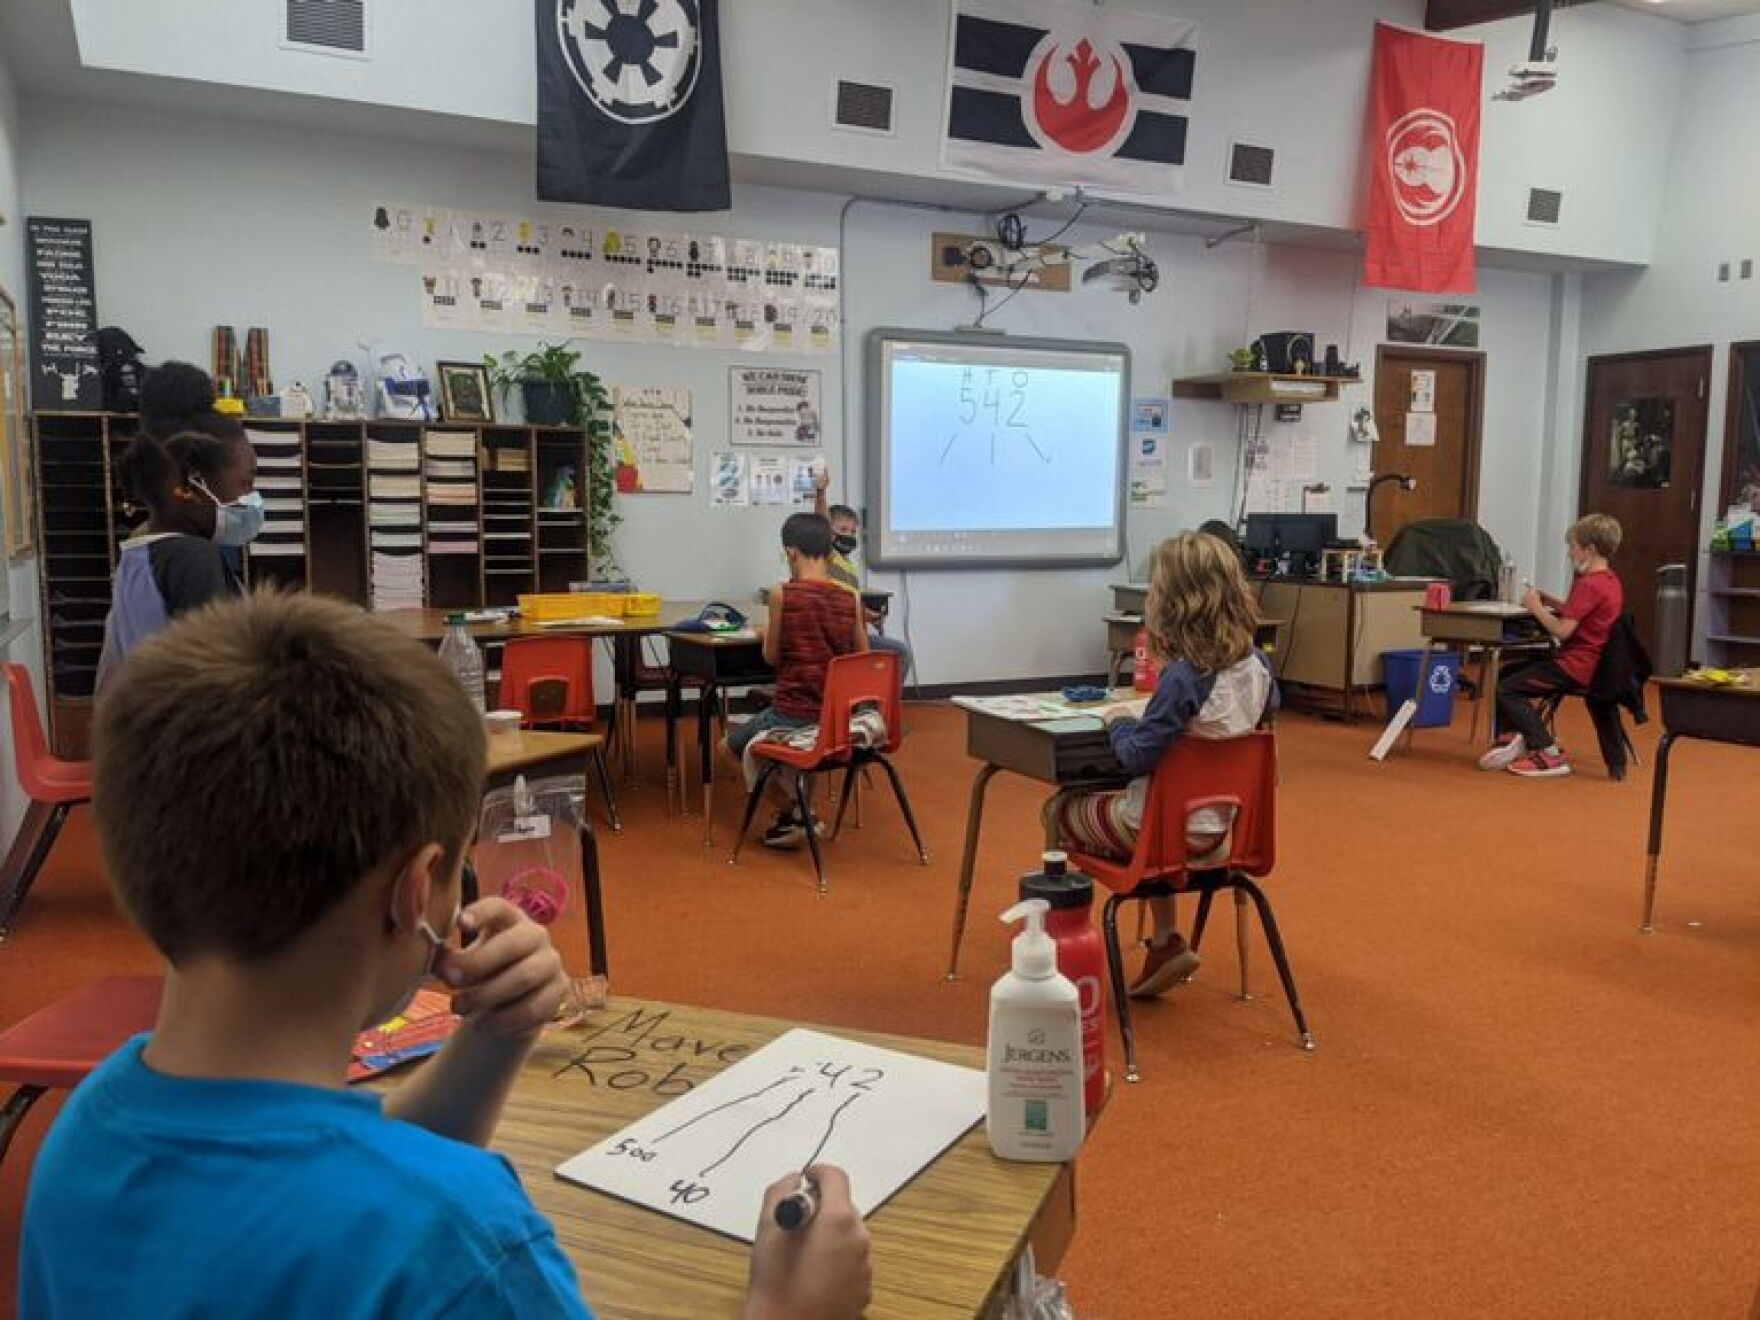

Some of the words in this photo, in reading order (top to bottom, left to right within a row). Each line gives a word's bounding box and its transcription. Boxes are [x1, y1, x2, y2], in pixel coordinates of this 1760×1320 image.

[492, 220, 506, 241] 2
[581, 228, 593, 250] 4
[624, 234, 637, 255] 5
[984, 369, 1003, 386] T
[959, 387, 1029, 428] 542
[606, 1138, 658, 1162] 500
[669, 1179, 709, 1204] 40
